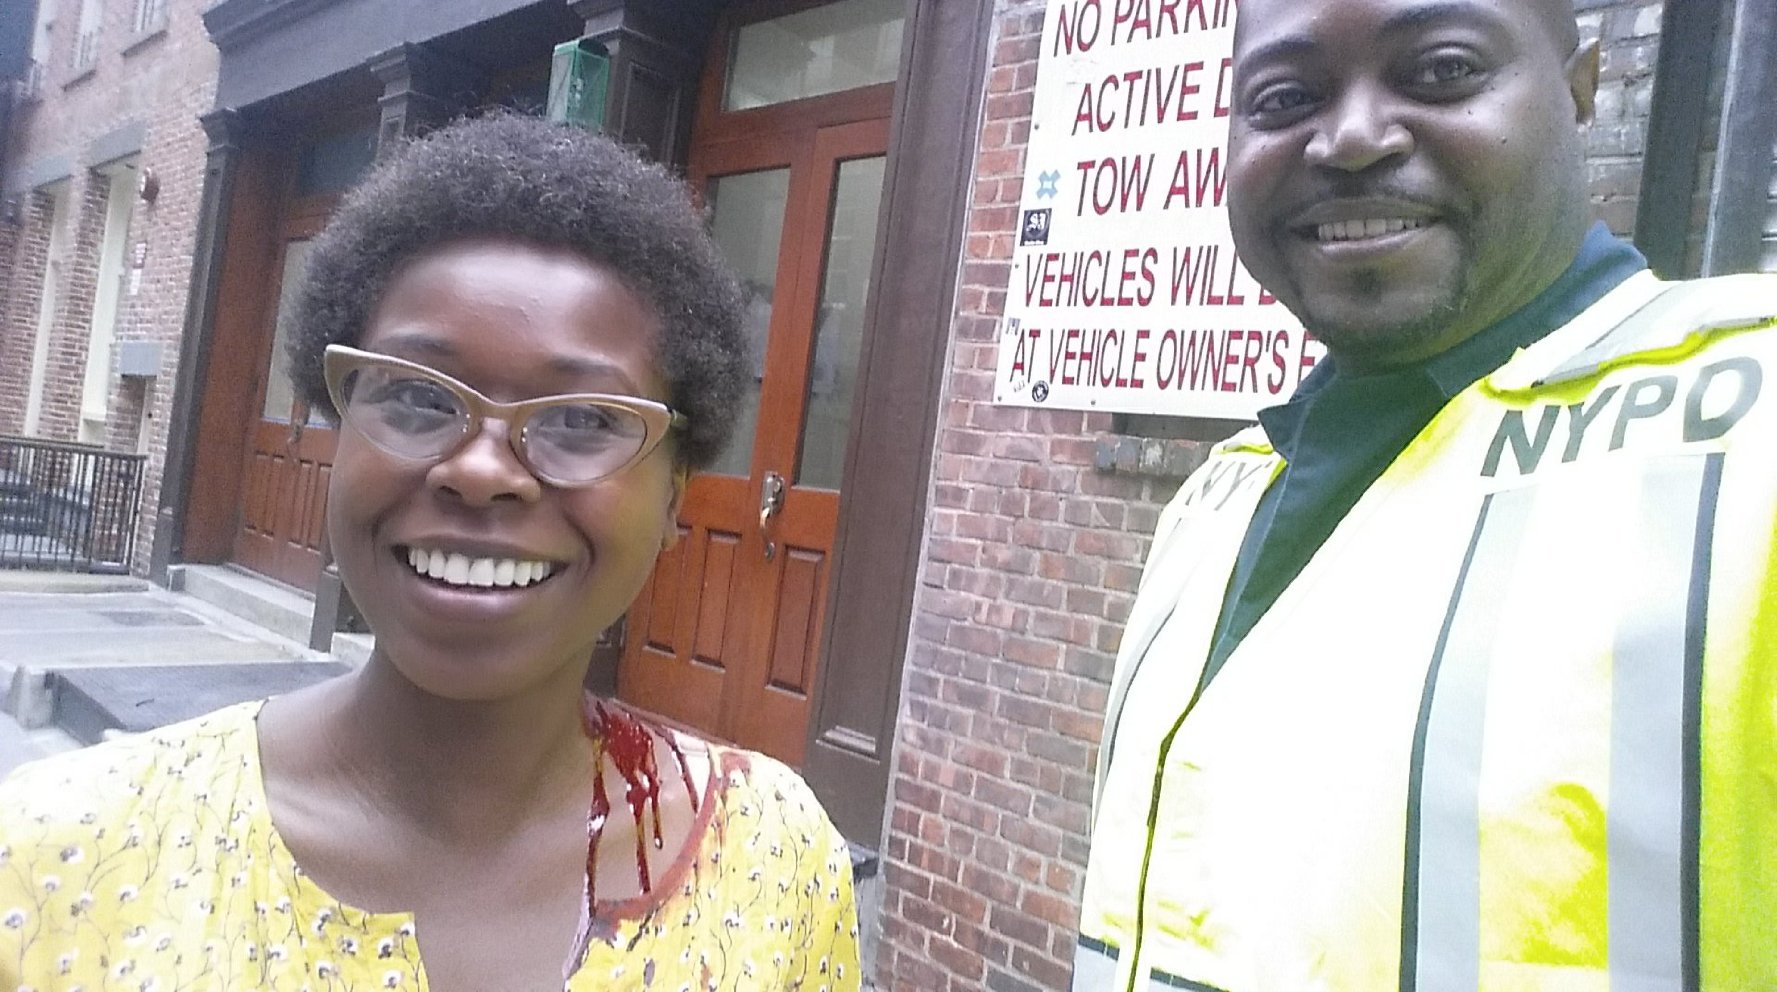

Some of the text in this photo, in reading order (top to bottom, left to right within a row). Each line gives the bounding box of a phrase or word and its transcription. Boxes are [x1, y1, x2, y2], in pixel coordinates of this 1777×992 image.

[1053, 0, 1101, 57] NO
[1071, 61, 1204, 136] ACTIVE
[1077, 153, 1155, 216] TOW
[1025, 244, 1244, 307] VEHICLES WILL
[1009, 328, 1041, 383] AT
[1049, 329, 1150, 389] VEHICLE
[1156, 329, 1289, 394] OWNER'S
[1480, 356, 1763, 477] NYPD
